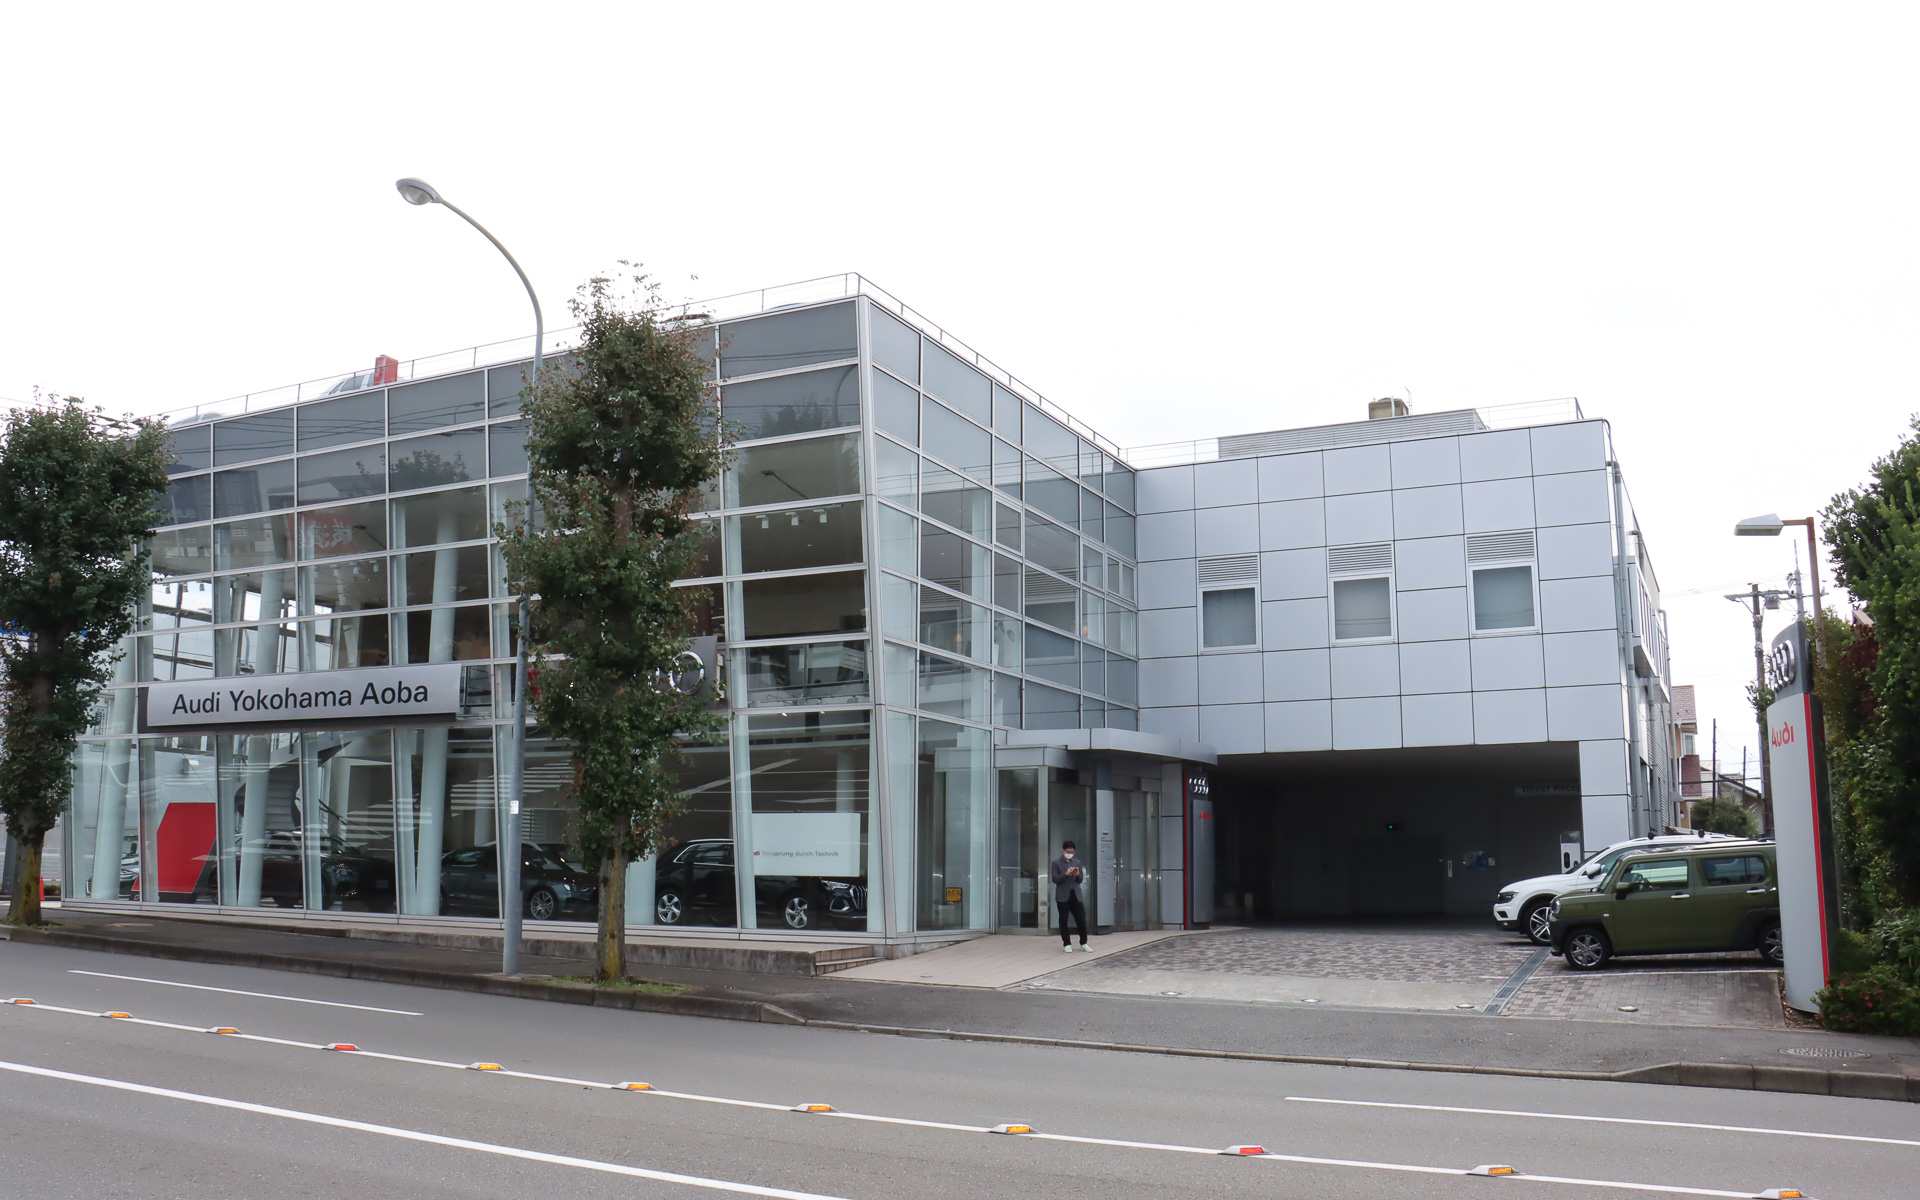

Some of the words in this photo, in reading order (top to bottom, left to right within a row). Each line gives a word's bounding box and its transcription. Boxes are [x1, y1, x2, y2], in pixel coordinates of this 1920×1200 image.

[172, 691, 220, 715] Audi
[229, 687, 352, 712] Yokohama
[360, 681, 429, 706] Aoba
[1771, 721, 1795, 749] Audi
